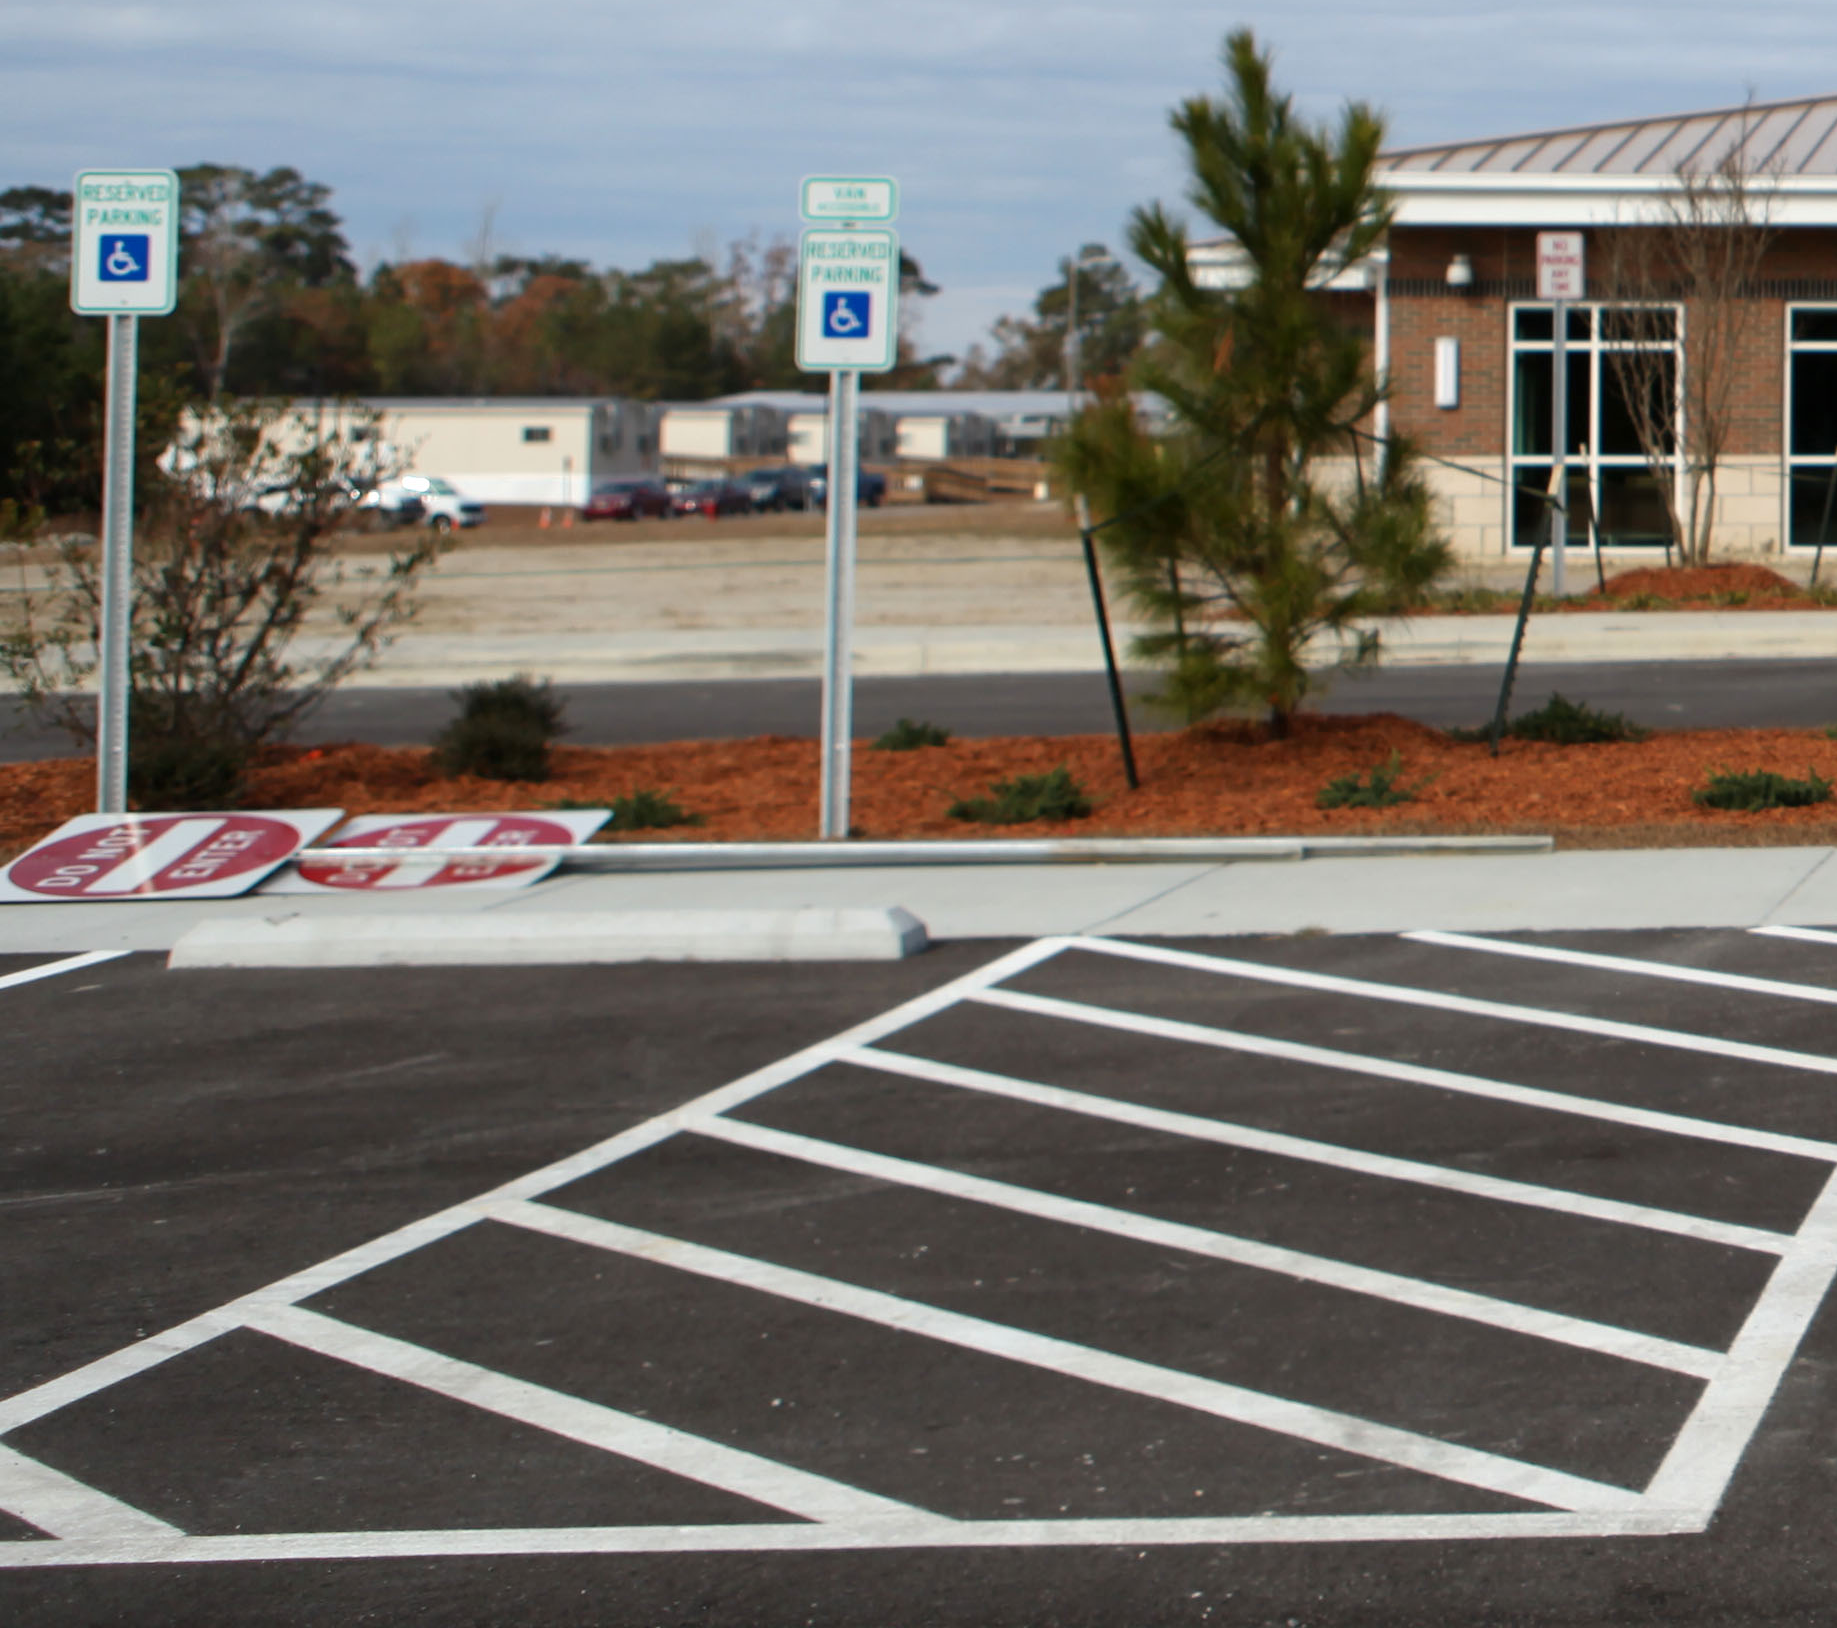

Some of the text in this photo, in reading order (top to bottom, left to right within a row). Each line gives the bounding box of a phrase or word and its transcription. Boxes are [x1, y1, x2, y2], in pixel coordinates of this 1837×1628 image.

[82, 184, 170, 202] RESERVED
[87, 208, 162, 225] PARKING
[806, 242, 893, 259] RESERVED
[811, 265, 882, 283] PARKING
[35, 826, 152, 888] DO NOT
[166, 829, 267, 879] ENTER
